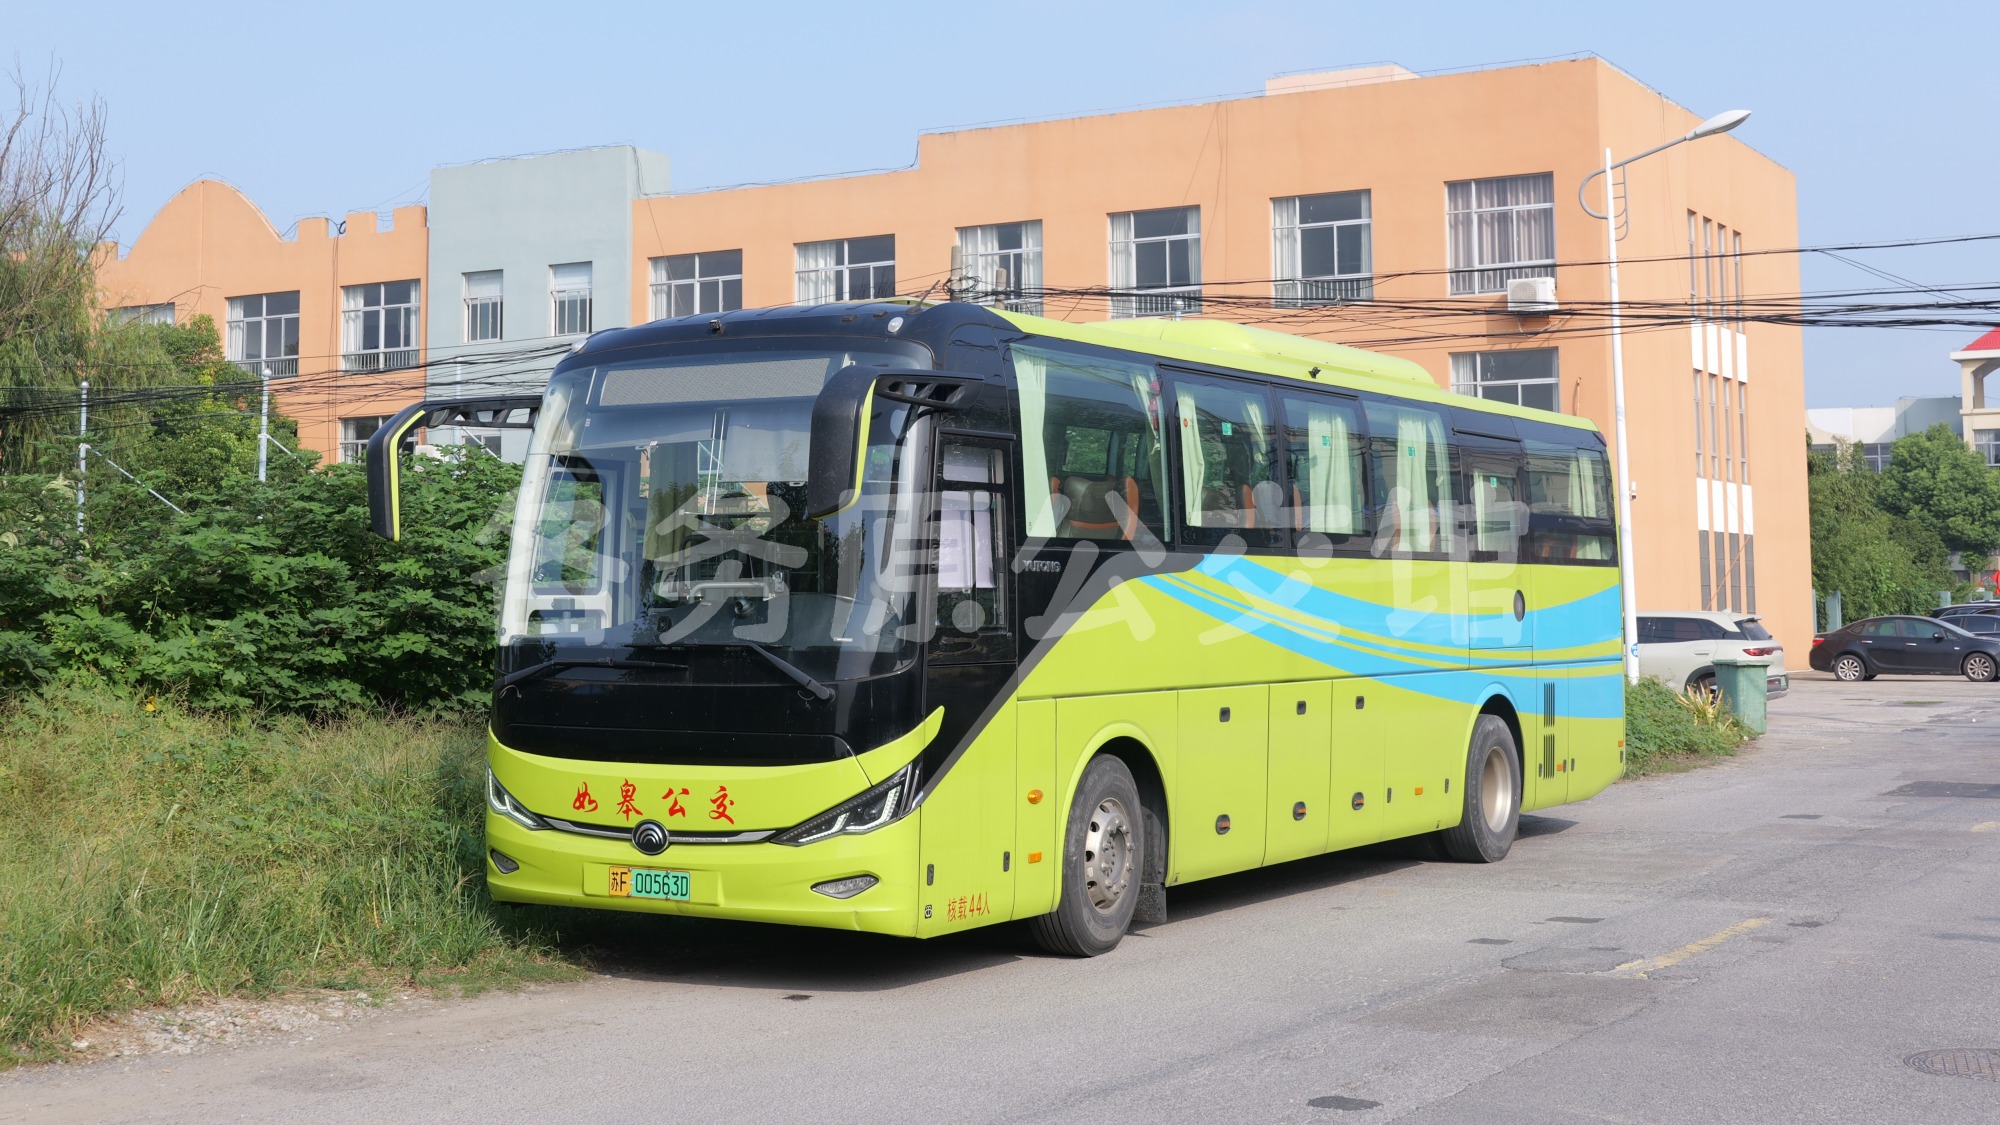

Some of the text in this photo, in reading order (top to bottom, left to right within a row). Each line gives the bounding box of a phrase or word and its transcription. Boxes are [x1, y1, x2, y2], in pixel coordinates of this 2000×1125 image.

[1022, 560, 1061, 572] YUTONG
[573, 778, 735, 825] 如皋公交
[947, 892, 990, 922] 核载44人
